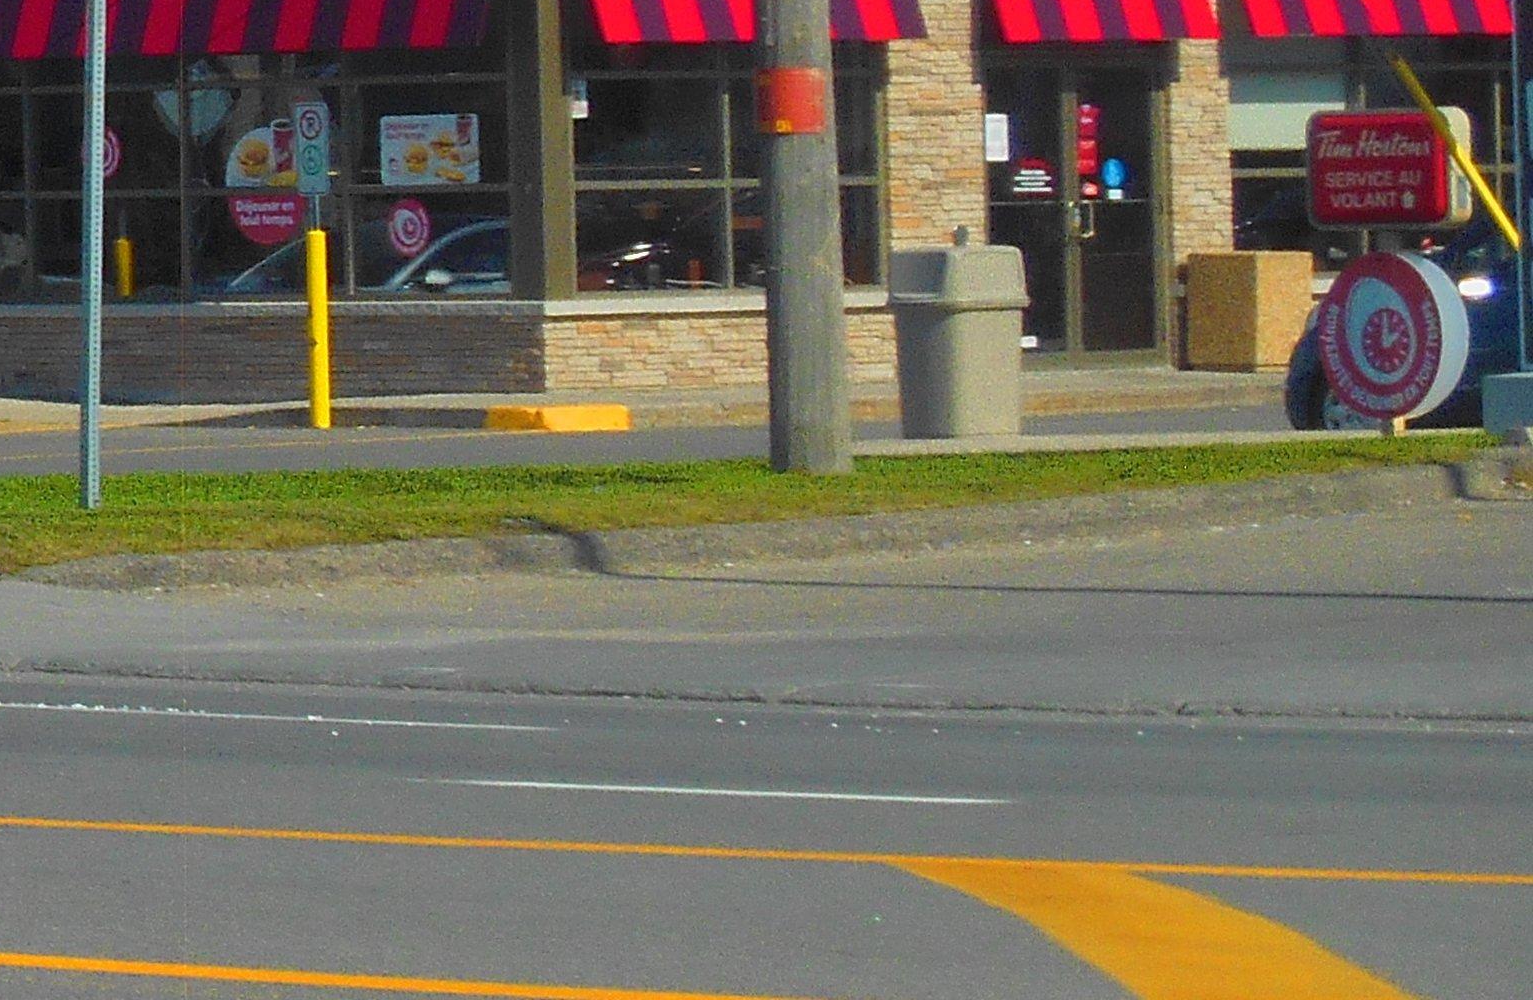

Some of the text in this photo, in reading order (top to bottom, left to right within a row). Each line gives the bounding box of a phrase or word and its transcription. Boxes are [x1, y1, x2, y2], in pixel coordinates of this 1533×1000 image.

[1324, 170, 1422, 188] SERVICE AU
[1331, 191, 1398, 208] VOLANT
